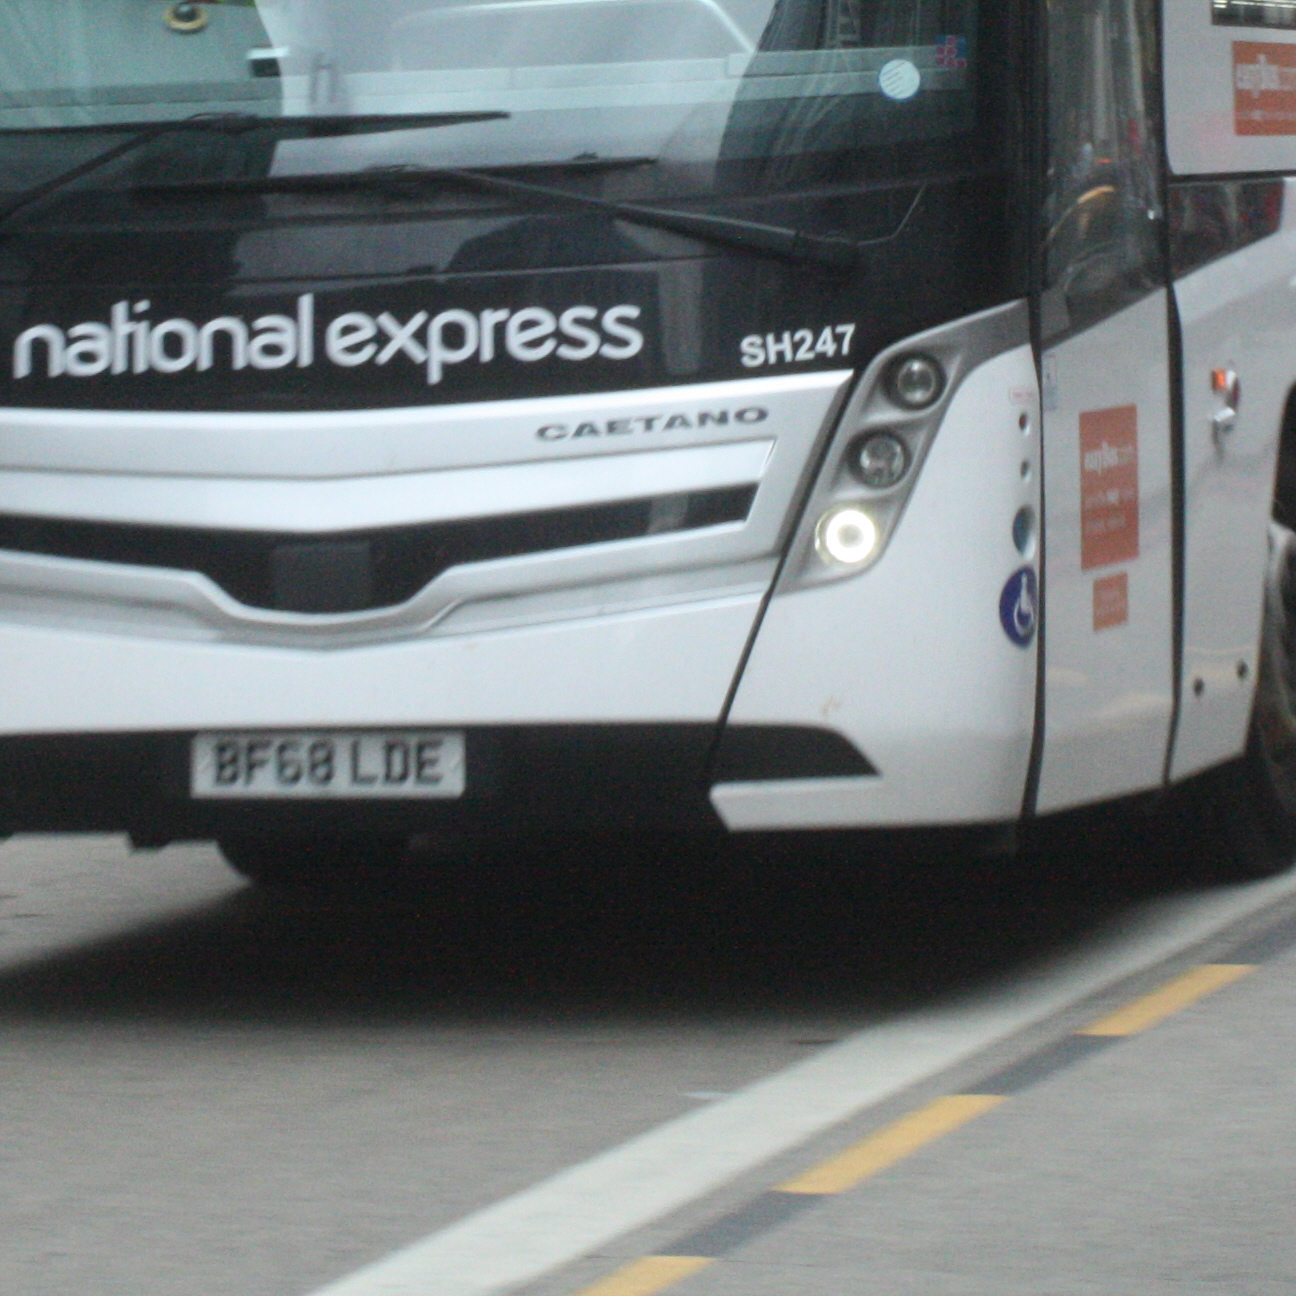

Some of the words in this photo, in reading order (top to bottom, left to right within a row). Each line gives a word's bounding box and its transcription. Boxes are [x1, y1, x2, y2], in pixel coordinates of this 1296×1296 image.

[14, 294, 314, 379] national
[325, 304, 645, 385] express
[739, 322, 856, 368] SH247
[535, 406, 769, 442] CAETANO
[212, 738, 337, 787] BF68
[349, 738, 444, 786] LDE
